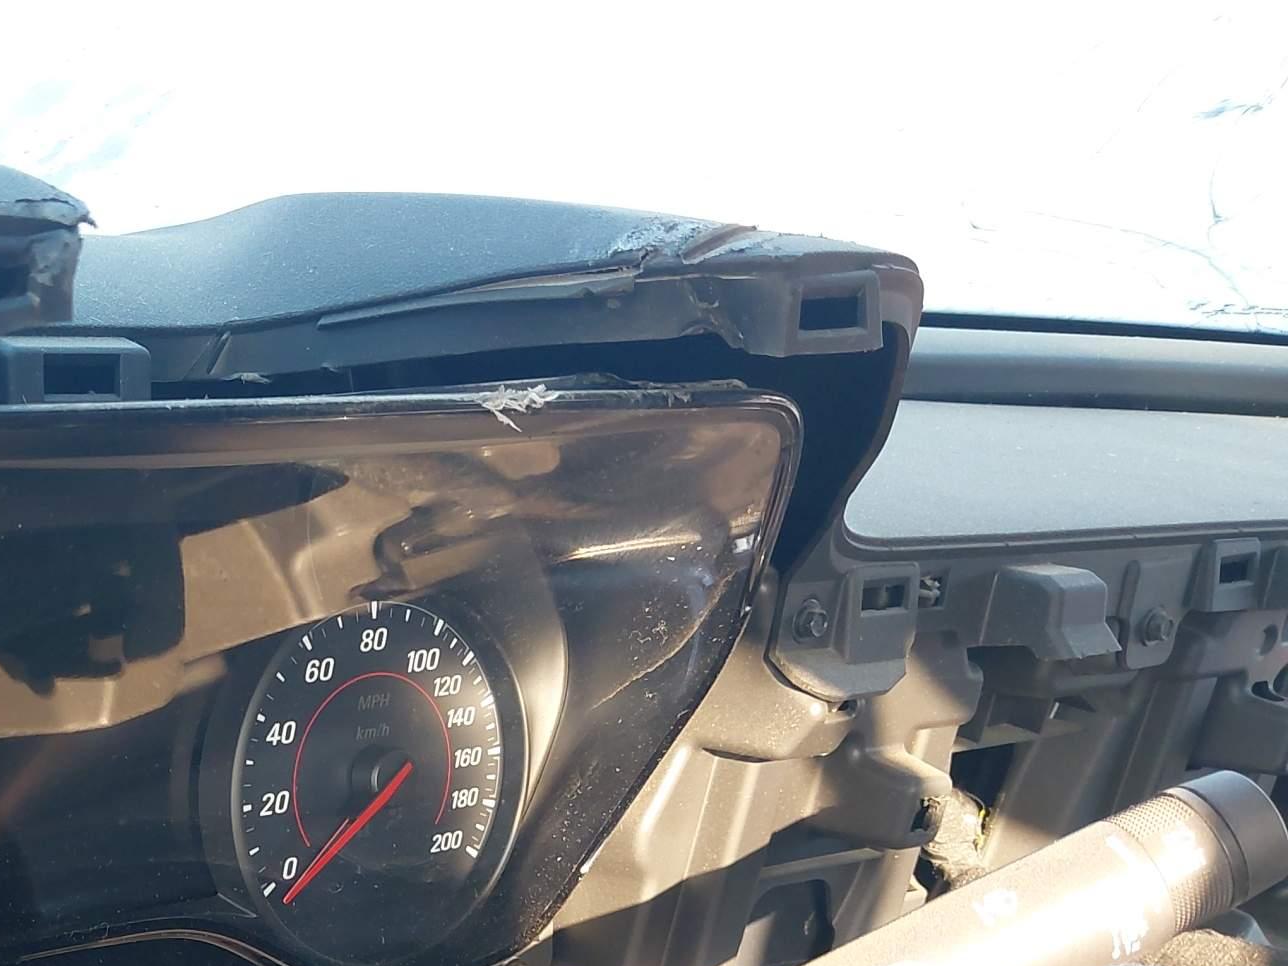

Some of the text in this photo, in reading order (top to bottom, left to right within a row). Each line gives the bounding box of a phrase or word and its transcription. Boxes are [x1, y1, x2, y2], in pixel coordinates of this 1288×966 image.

[359, 627, 388, 652] 80
[305, 657, 335, 683] 60
[407, 648, 440, 673] 100
[433, 674, 462, 697] 120
[358, 693, 391, 712] MPH
[447, 706, 476, 728] 140
[265, 720, 296, 746] 40
[355, 724, 391, 741] km/h
[454, 746, 482, 768] 160
[259, 790, 290, 817] 20
[451, 787, 479, 809] 180
[430, 830, 463, 853] 200
[281, 857, 298, 880] 0
